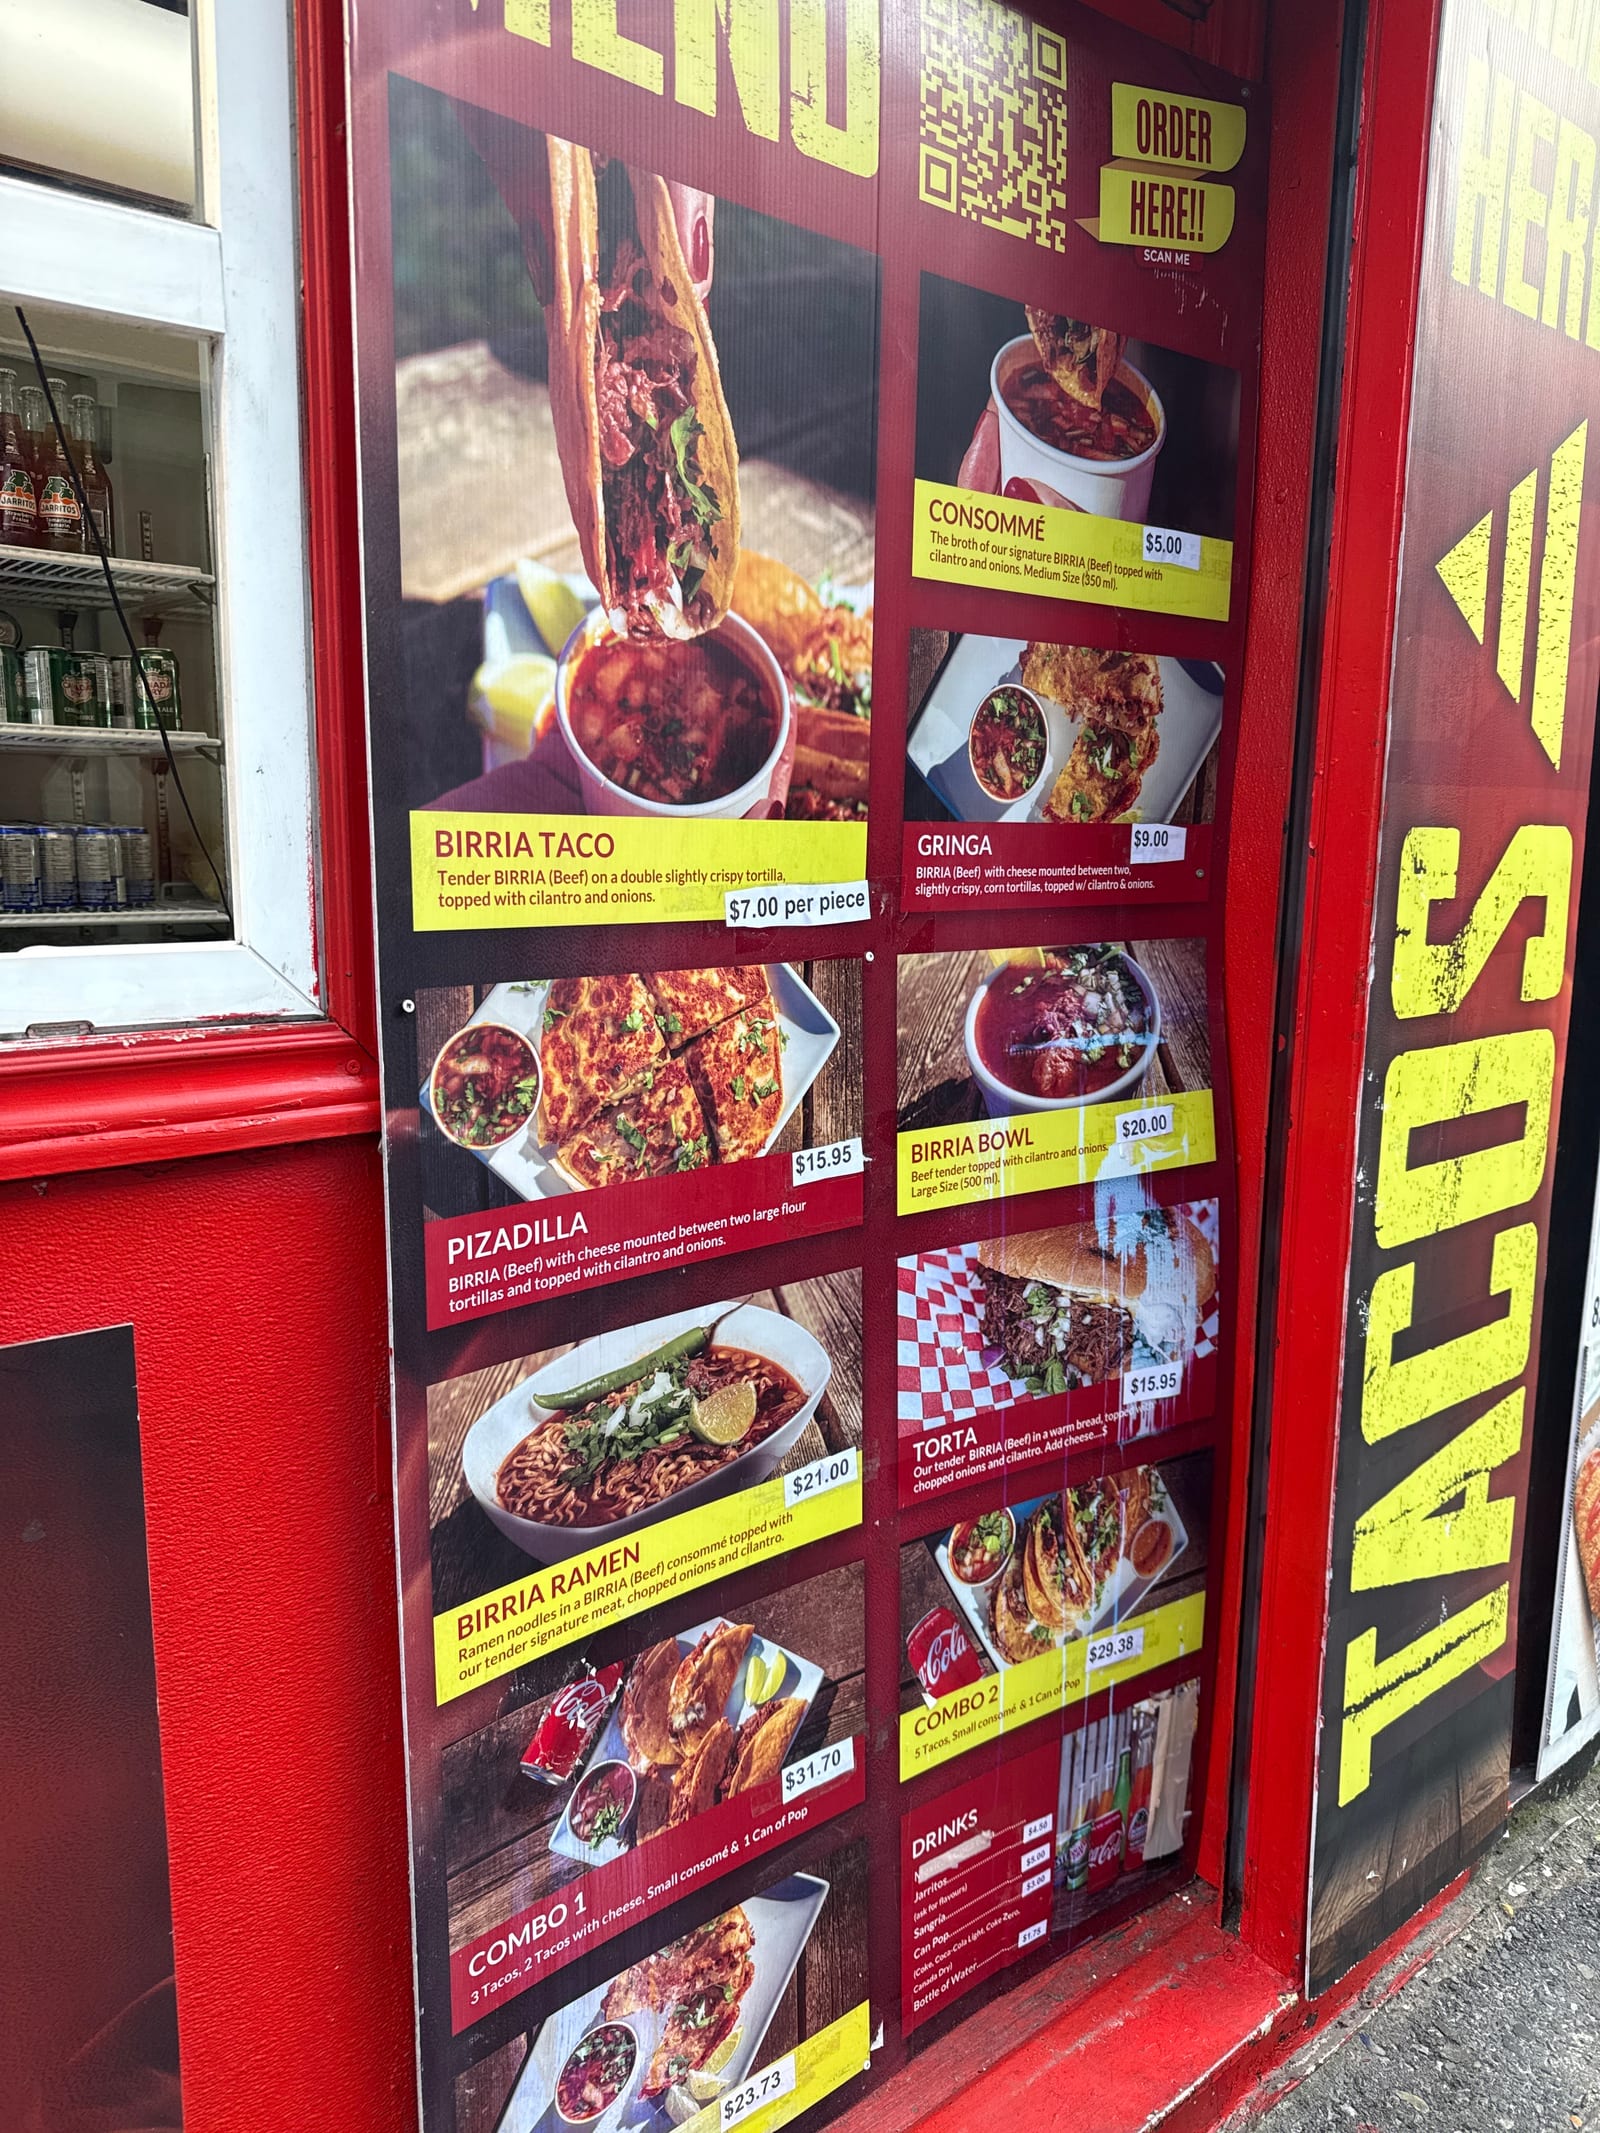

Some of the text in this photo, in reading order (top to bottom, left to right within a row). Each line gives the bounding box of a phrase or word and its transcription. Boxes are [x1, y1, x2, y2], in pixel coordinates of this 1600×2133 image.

[1136, 98, 1212, 164] ORDER
[1130, 180, 1205, 242] HERE!!
[1450, 52, 1600, 352] HER
[1143, 249, 1190, 266] SCAN ME
[0, 496, 35, 510] JARRITOS
[41, 504, 76, 514] JARRITOS
[929, 499, 1046, 541] CONSOMMÉ
[930, 530, 1162, 581] The broth our signature BIRRIA (Beef) topped with
[1146, 533, 1182, 554] $5.00
[930, 549, 1101, 588] cilantro and onions. Medium Size (350
[435, 830, 615, 859] BIRRIA TACO
[917, 834, 993, 856] GRINGA
[1134, 830, 1169, 849] $9.00
[437, 867, 786, 887] Tender BIRRIA (Beef) on double slightly crispy tortilla,
[915, 878, 1155, 898] slightly crispy, corn tortillas, topped cilantro onions.
[916, 864, 1132, 880] BIRRIA (Beef) with cheese mounted between two,
[438, 888, 656, 910] topped with cilantro and onions.
[729, 890, 865, 924] $7.00 per piece
[1122, 1114, 1167, 1138] $20.00
[796, 1145, 852, 1176] $15.95
[911, 1127, 1034, 1164] BIRRIA BOWL
[911, 1142, 1108, 1183] Beef tender topped with cilantro and onions.
[911, 1175, 982, 1198] Large Size (500
[448, 1211, 589, 1265] PIZADILLA
[449, 1200, 807, 1293] BIRRIA (Beef) with cheese mounted between two large flour
[449, 1235, 727, 1313] tortillas and topped with cilantro and onions.
[1338, 824, 1572, 1808] TACOS
[1131, 1373, 1177, 1396] $15.95
[912, 1426, 978, 1462] TORTA
[913, 1413, 1104, 1479] Our tender BIRRIA (Beef) warm bread,
[793, 1458, 849, 1496] $21.00
[913, 1437, 1063, 1493] chopped onions and cilantro. Add
[457, 1541, 640, 1641] BIRRIA RAMEN
[458, 1511, 793, 1663] Ramen noodles BIRRIA (Beef) consommé topped with
[459, 1535, 785, 1681] our tender signature meat, chopped onions and cilantro.
[1089, 1635, 1134, 1664] $29.38
[914, 1684, 999, 1737] COMBO 2
[922, 1678, 1081, 1755] Tacos, Small consomé Can Pop
[785, 1749, 841, 1792] $31.70
[912, 1808, 978, 1860] DRINKS
[1027, 1820, 1049, 1836] $4.50
[1026, 1849, 1047, 1867] $5.00
[939, 1882, 968, 1907] flavours)
[1026, 1874, 1046, 1891] $3.00
[481, 1805, 809, 1998] Tacos, Tacos with cheese, Small consomé Can Pop
[468, 1891, 587, 1978] COMBO 1
[913, 1942, 931, 1960] Can
[934, 1937, 968, 1965] Coca-Cola
[1022, 1927, 1042, 1943] $1.75
[913, 1986, 940, 2013] Bottle
[724, 2070, 782, 2121] $23.73
